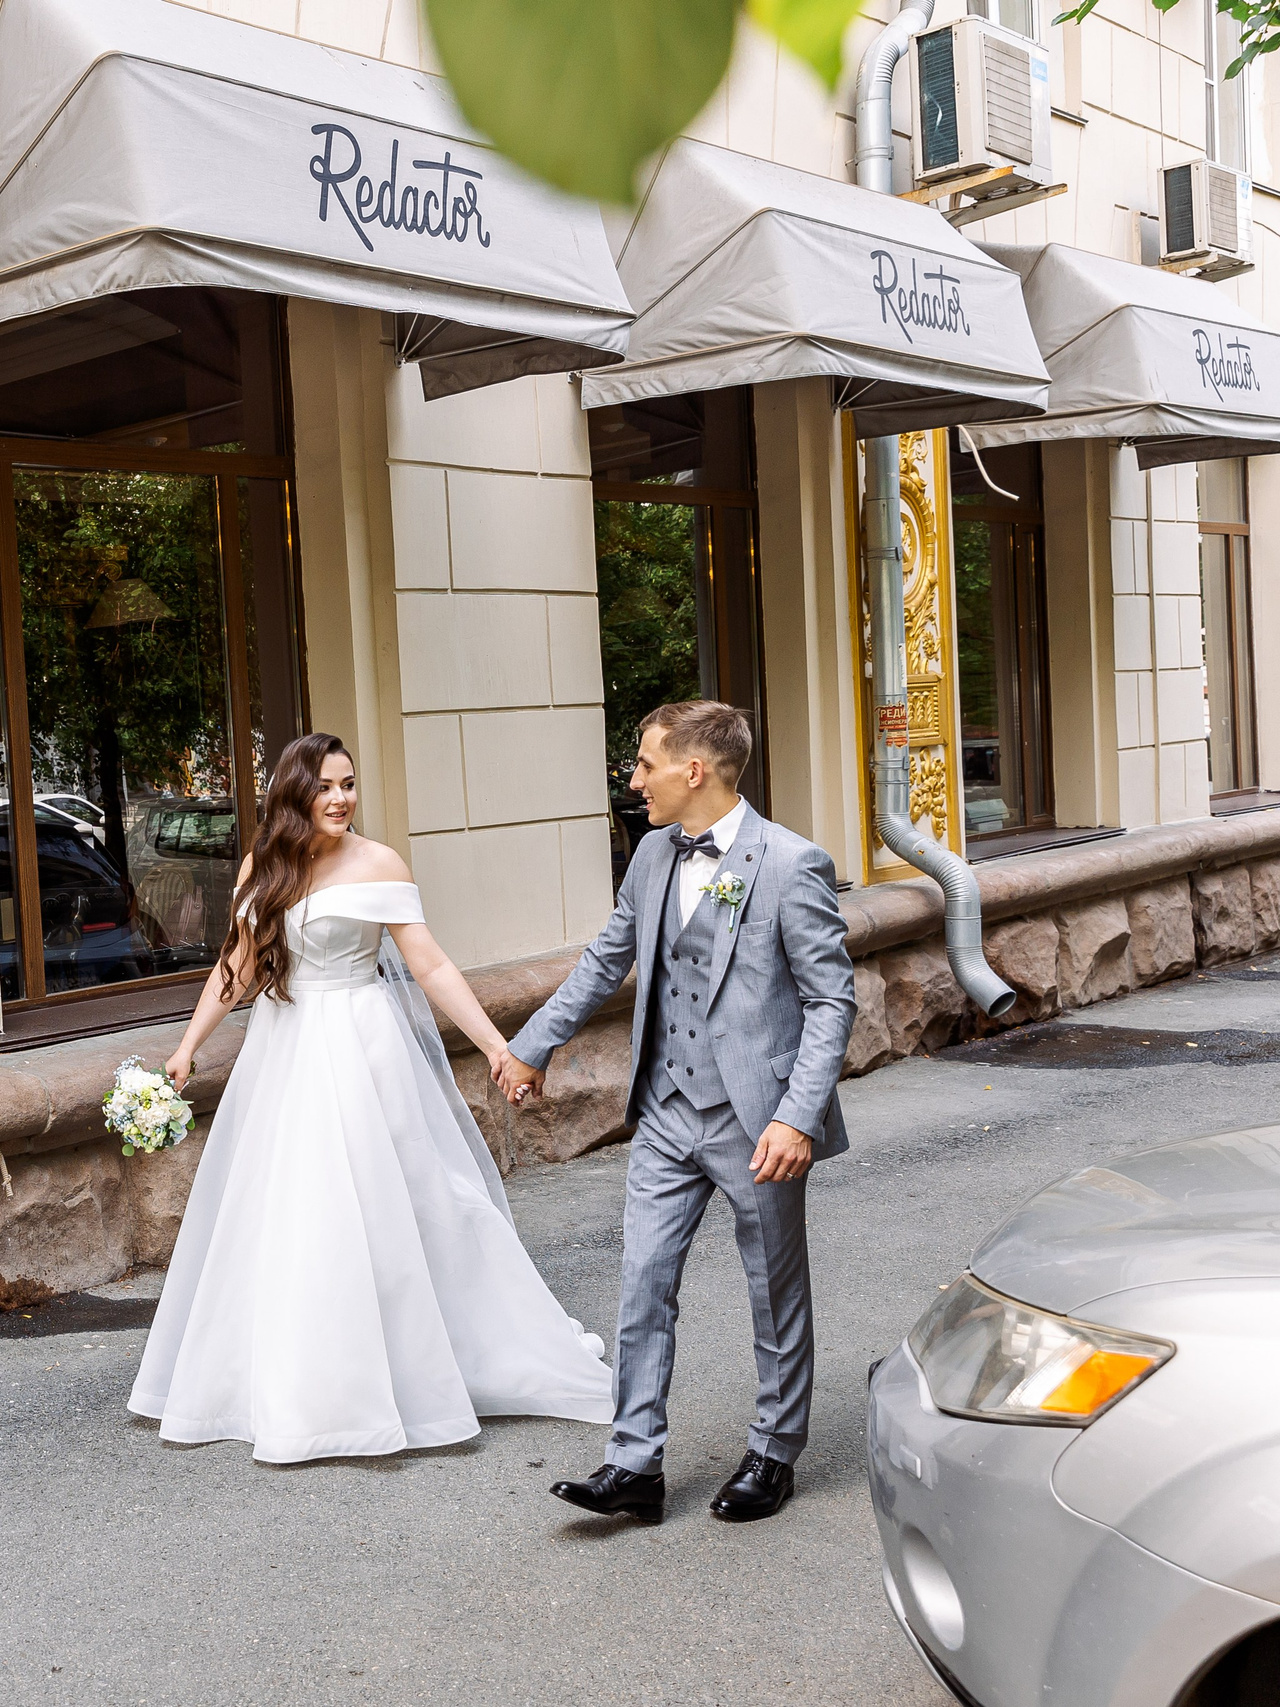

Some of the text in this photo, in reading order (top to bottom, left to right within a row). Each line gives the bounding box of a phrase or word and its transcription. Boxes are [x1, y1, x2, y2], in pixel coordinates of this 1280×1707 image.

[309, 122, 491, 252] Redactor
[869, 249, 971, 345] Redactor
[1192, 327, 1261, 402] Redactor
